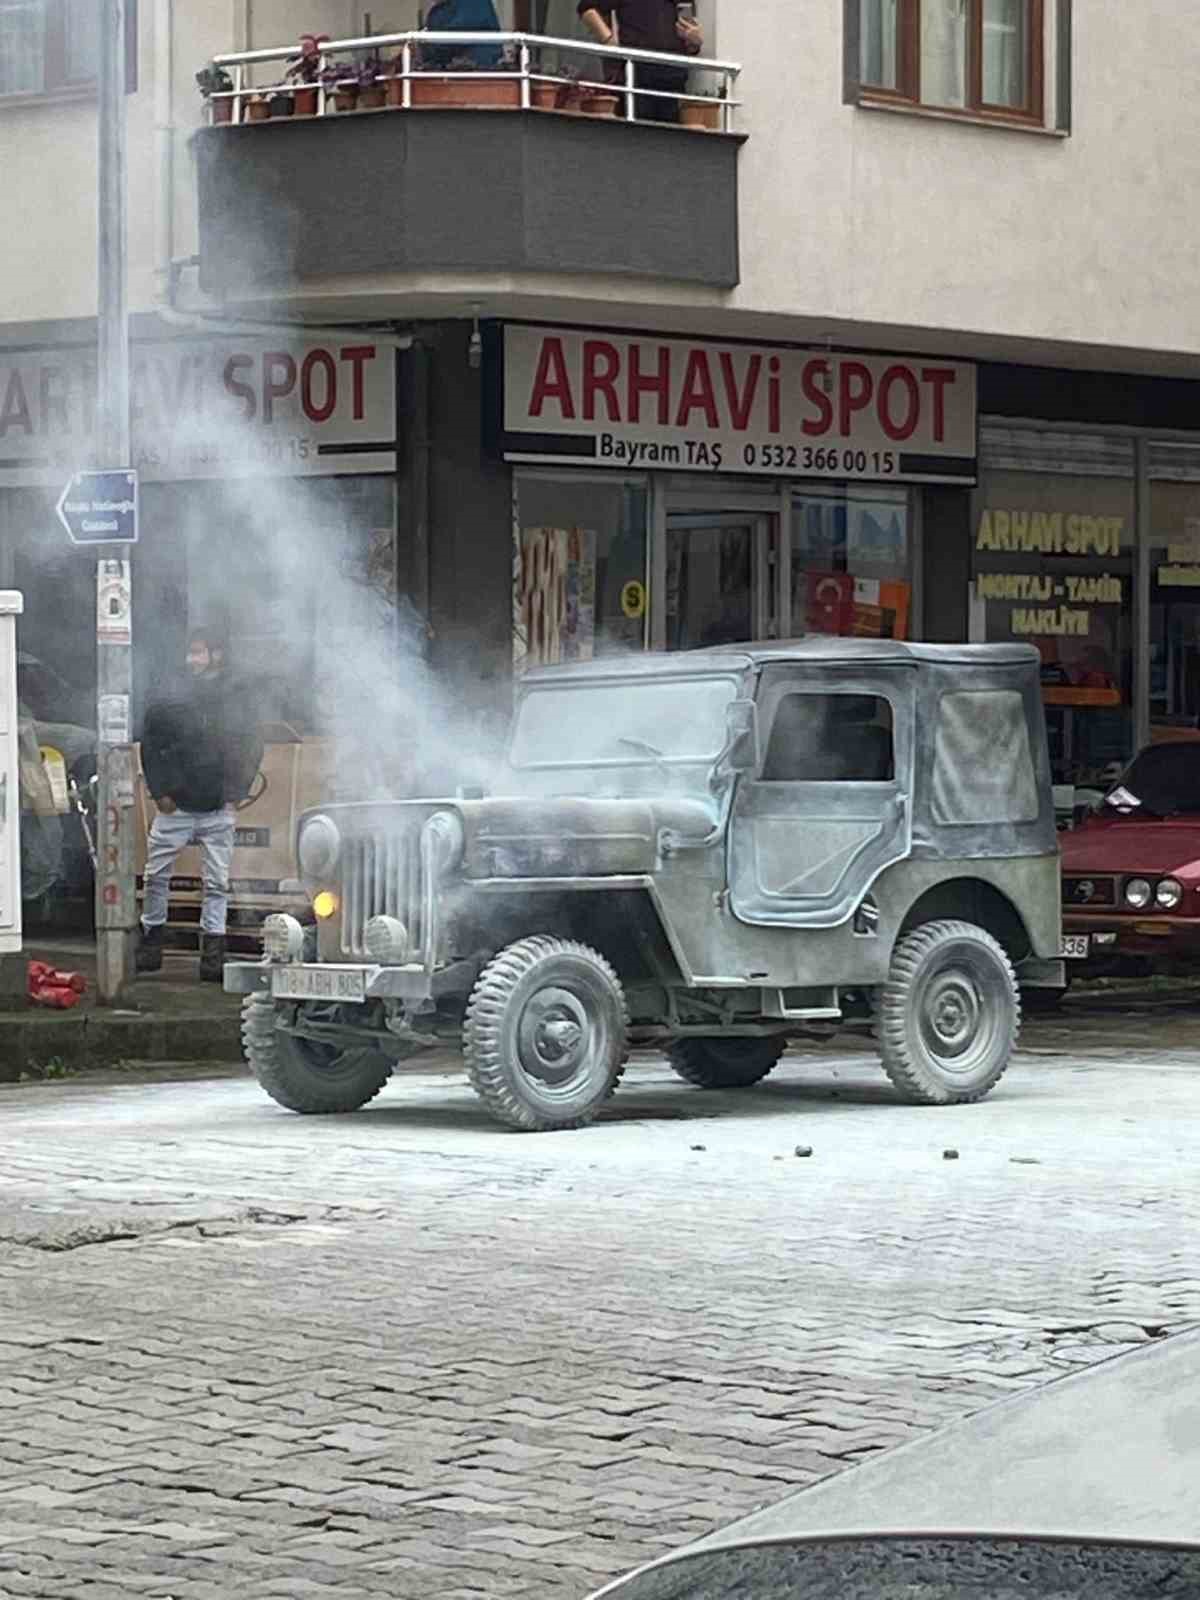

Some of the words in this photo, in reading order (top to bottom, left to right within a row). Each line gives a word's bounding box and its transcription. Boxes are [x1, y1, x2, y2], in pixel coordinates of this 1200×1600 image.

[222, 345, 376, 424] SPOT
[801, 357, 957, 442] SPOT
[600, 433, 680, 465] Bayram
[685, 441, 722, 470] TAŞ
[743, 443, 757, 465] 0
[762, 445, 797, 468] 532
[803, 448, 838, 471] 366
[843, 451, 867, 473] 00
[872, 452, 894, 474] 15
[1064, 513, 1125, 556] SPOT
